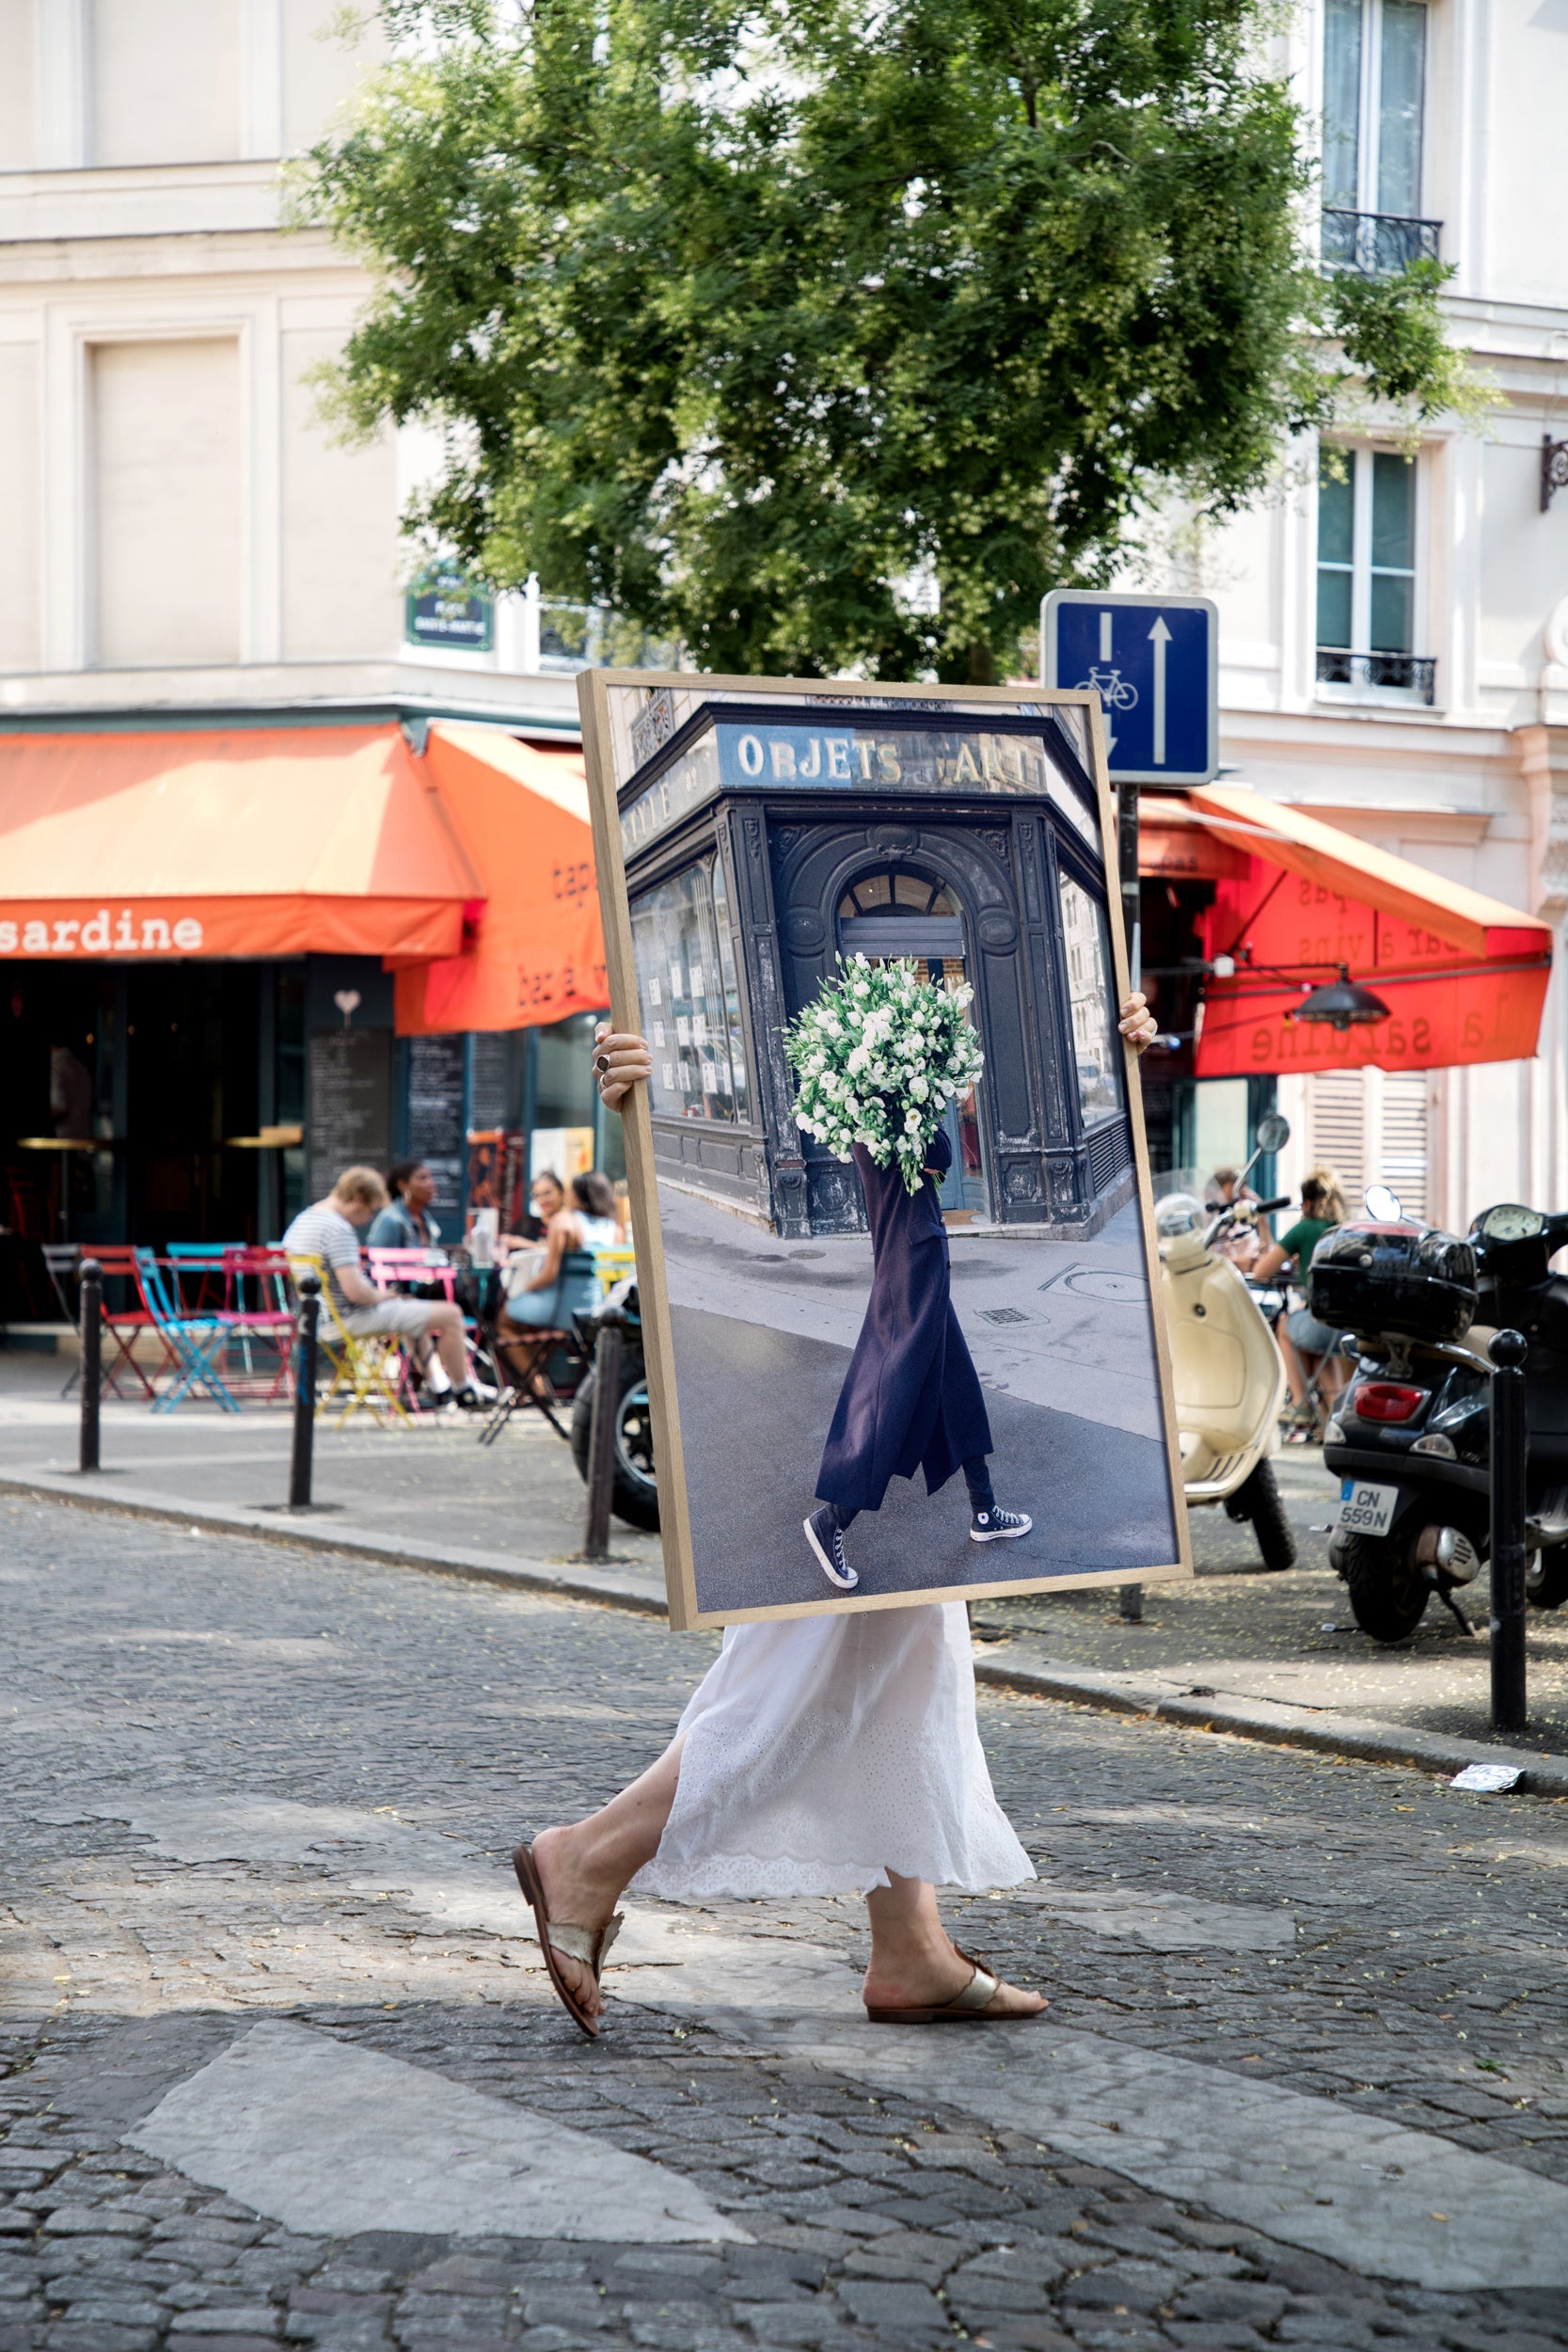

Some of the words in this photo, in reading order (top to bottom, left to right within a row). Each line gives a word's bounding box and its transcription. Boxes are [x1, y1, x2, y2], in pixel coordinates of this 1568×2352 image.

[737, 735, 901, 786] OBJETS
[0, 909, 203, 952] sardine
[1356, 1490, 1380, 1508] CN
